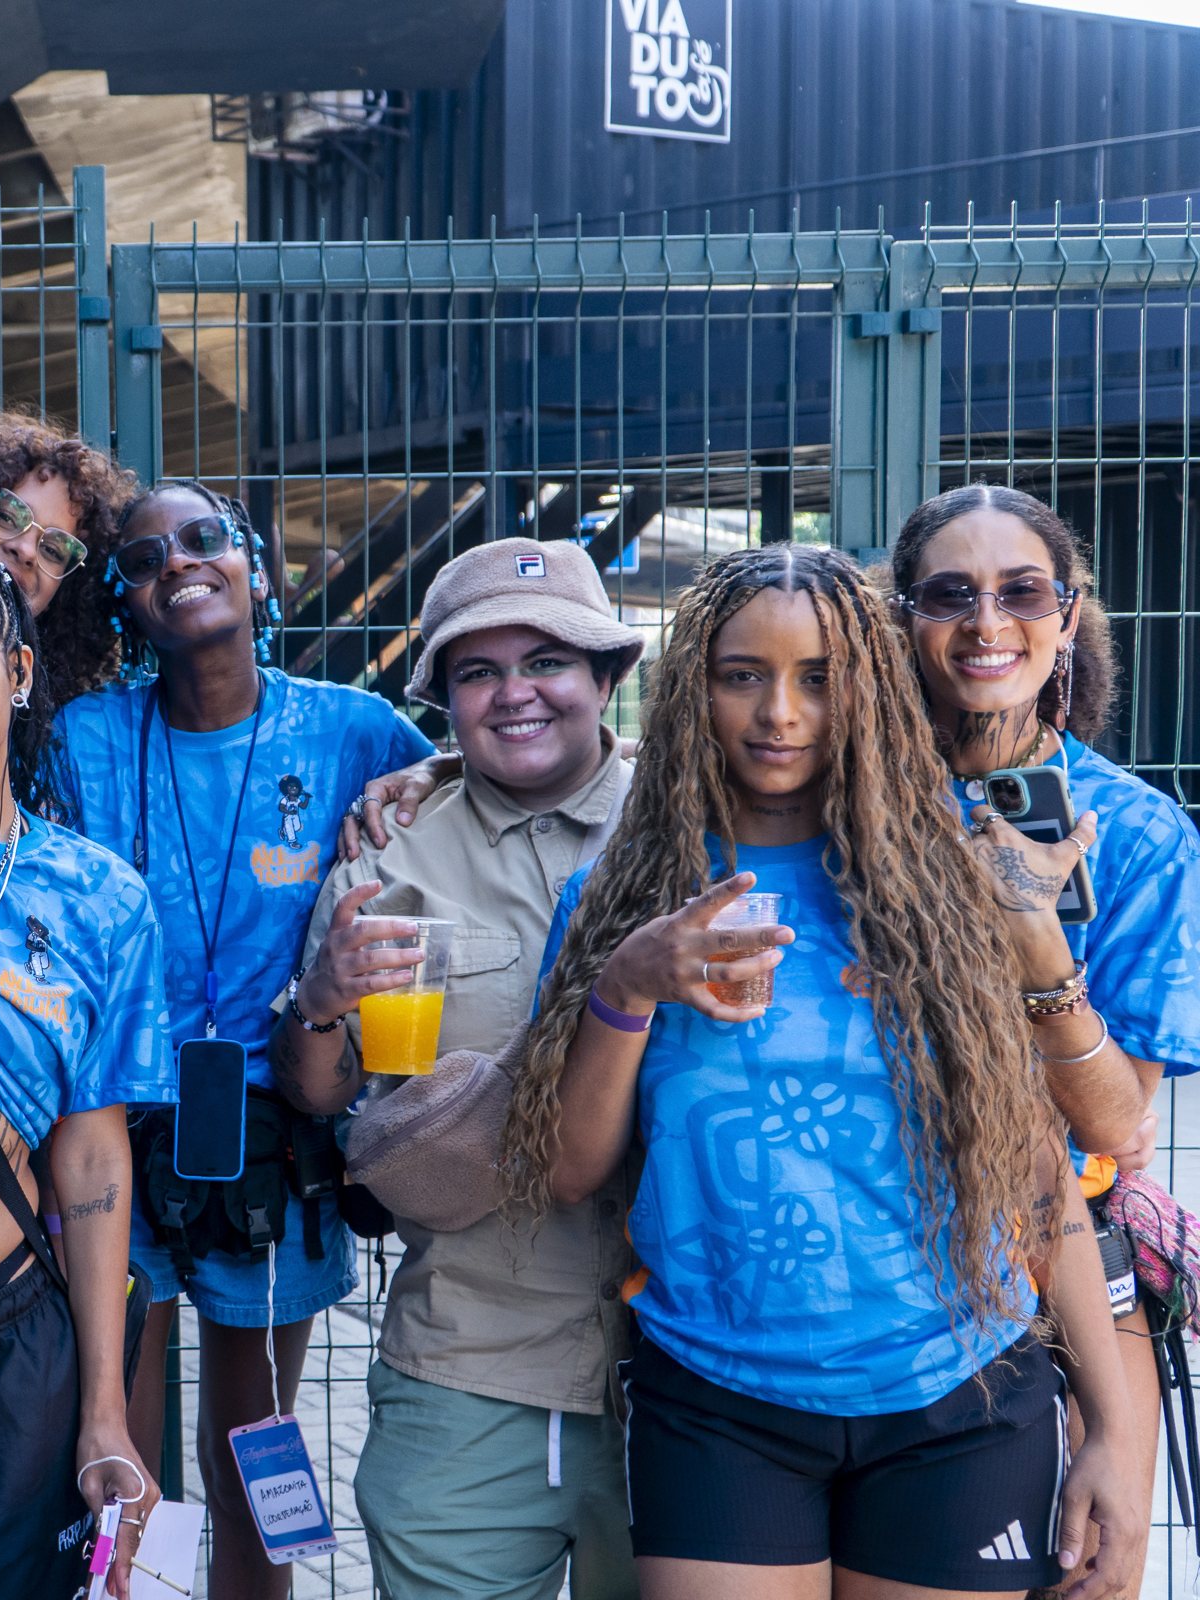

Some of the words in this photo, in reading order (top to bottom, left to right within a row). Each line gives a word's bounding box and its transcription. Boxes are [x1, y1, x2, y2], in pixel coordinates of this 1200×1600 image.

[619, 0, 690, 38] VIA
[630, 31, 689, 79] DU
[629, 73, 689, 122] TO
